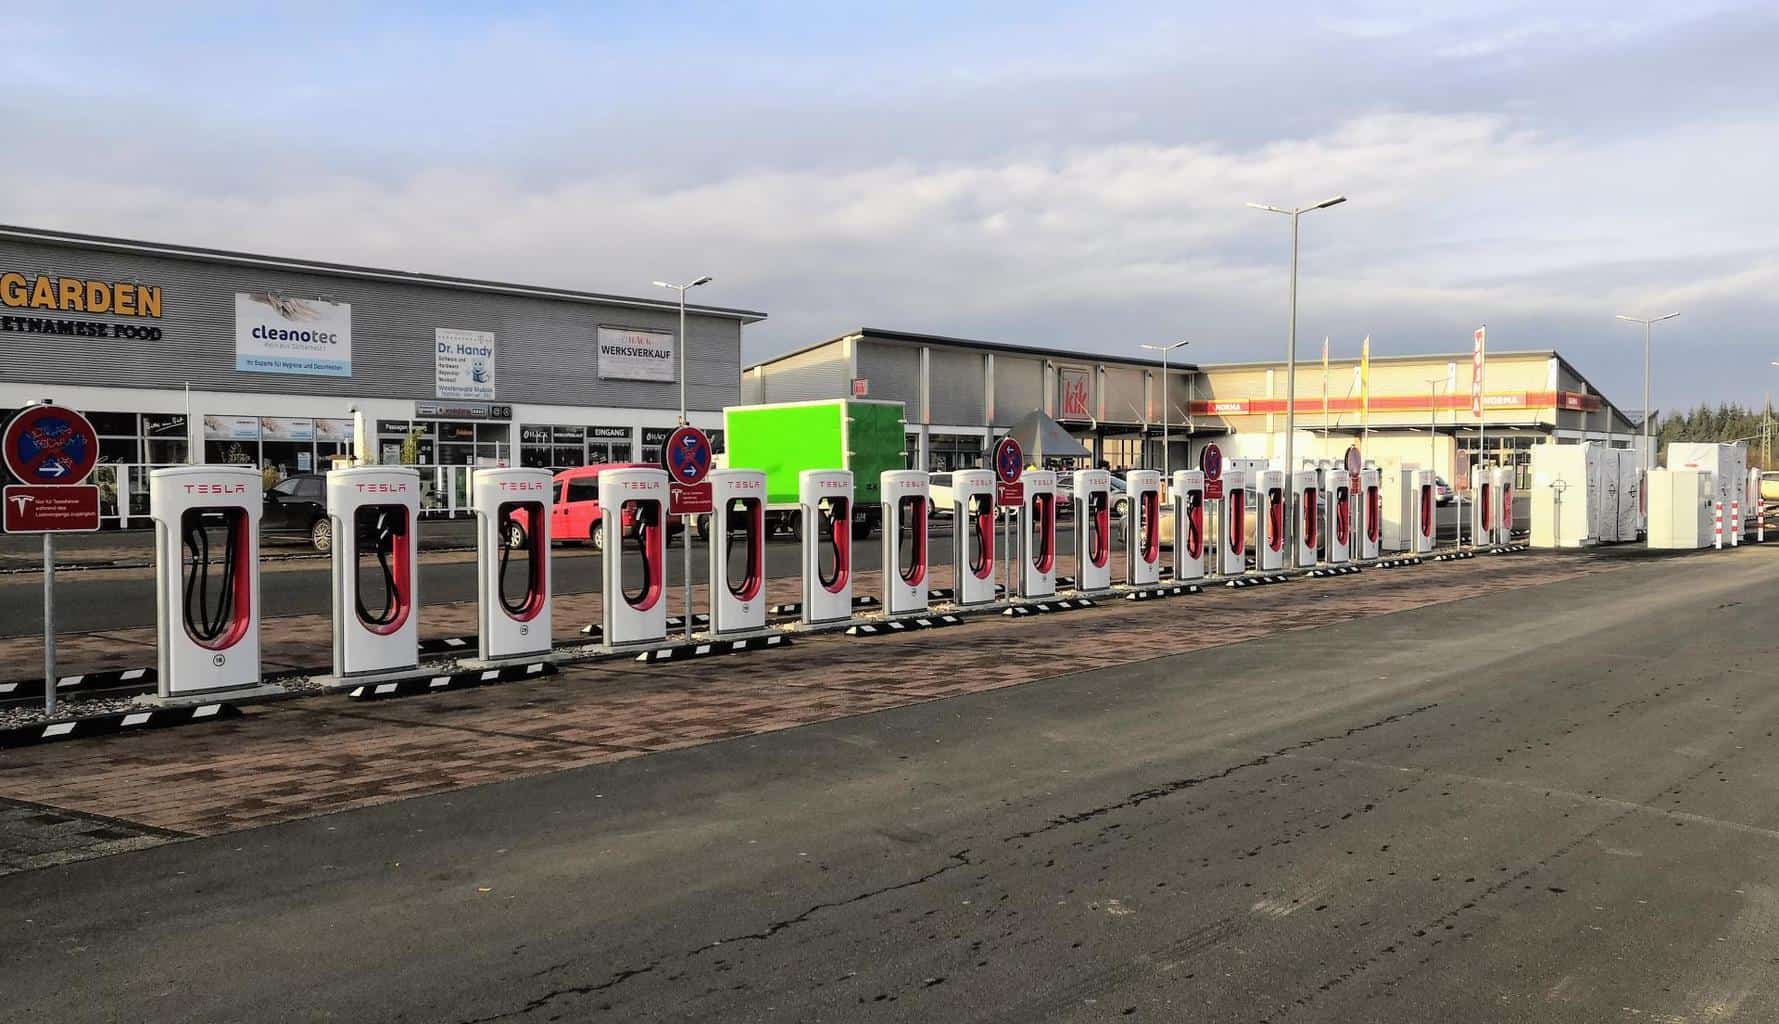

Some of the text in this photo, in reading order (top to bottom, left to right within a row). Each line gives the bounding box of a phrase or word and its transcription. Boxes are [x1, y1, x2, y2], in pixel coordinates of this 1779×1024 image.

[0, 272, 162, 318] GARDEN
[113, 324, 162, 340] FOOD
[252, 325, 337, 344] cleanotec
[438, 342, 492, 358] Dr. Handy
[601, 345, 671, 359] WERKSVERKAUF
[595, 429, 625, 437] EINGANG
[184, 484, 248, 494] TESLA
[356, 483, 406, 493] TESLA
[500, 482, 543, 491] TESLA
[622, 481, 660, 490] TESLA
[728, 481, 761, 489] TESLA
